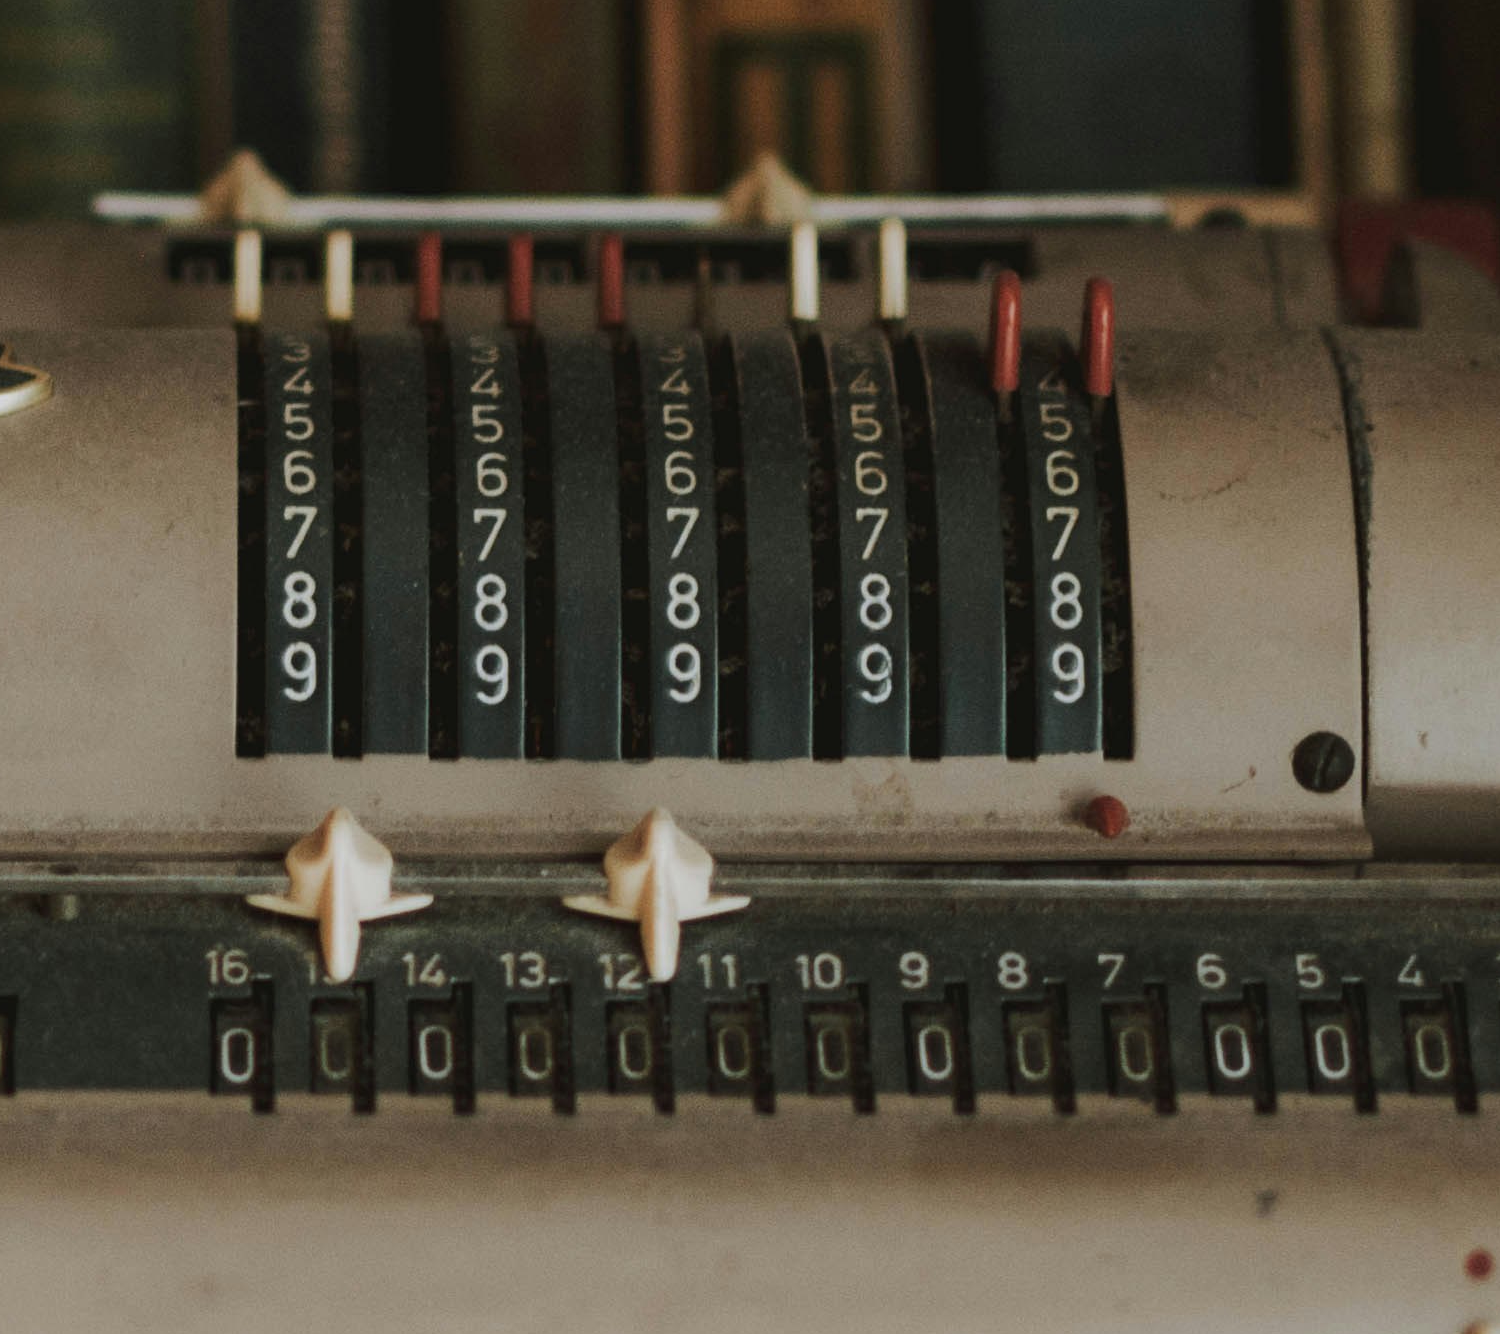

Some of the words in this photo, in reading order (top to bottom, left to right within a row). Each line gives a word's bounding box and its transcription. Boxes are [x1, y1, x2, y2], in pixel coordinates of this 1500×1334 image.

[283, 367, 314, 395] 4
[470, 368, 502, 398] 4
[660, 368, 691, 396] 4
[848, 369, 879, 396] 4
[283, 402, 315, 441] 5
[471, 404, 504, 444] 5
[662, 403, 694, 442] 5
[850, 403, 883, 443] 5
[1039, 403, 1074, 443] 5
[283, 449, 317, 495] 6
[476, 452, 508, 498] 6
[664, 450, 697, 496] 6
[854, 450, 888, 497] 6
[1045, 449, 1080, 497] 6
[283, 505, 318, 559] 7
[473, 508, 507, 562] 7
[666, 506, 700, 559] 7
[855, 507, 889, 560] 7
[1045, 506, 1079, 561] 7
[282, 570, 317, 629] 8
[473, 573, 508, 632] 8
[666, 572, 701, 630] 8
[858, 572, 893, 631] 8
[1049, 571, 1083, 630] 8
[281, 641, 317, 702] 9
[474, 644, 509, 706] 9
[666, 642, 701, 703] 9
[857, 642, 893, 705] 9
[1050, 642, 1085, 704] 9
[205, 948, 250, 986] 16
[401, 951, 446, 987] 14
[499, 950, 546, 988] 13
[598, 952, 644, 990] 12
[697, 952, 736, 989] 11
[795, 952, 843, 990] 10
[899, 951, 930, 989] 9
[997, 951, 1029, 990] 8
[1096, 952, 1125, 988] 7
[1196, 952, 1227, 989] 6
[1295, 953, 1324, 989] 5
[1397, 954, 1424, 987] 4
[220, 1027, 254, 1084] 0
[418, 1025, 453, 1080] 0
[519, 1030, 553, 1081] 0
[618, 1027, 649, 1080] 0
[717, 1027, 749, 1079] 0
[816, 1029, 848, 1080] 0
[918, 1025, 953, 1081] 0
[1016, 1026, 1051, 1082] 0
[1119, 1026, 1153, 1083] 0
[1214, 1026, 1252, 1079] 0
[1314, 1025, 1351, 1081] 0
[1414, 1025, 1451, 1080] 0
